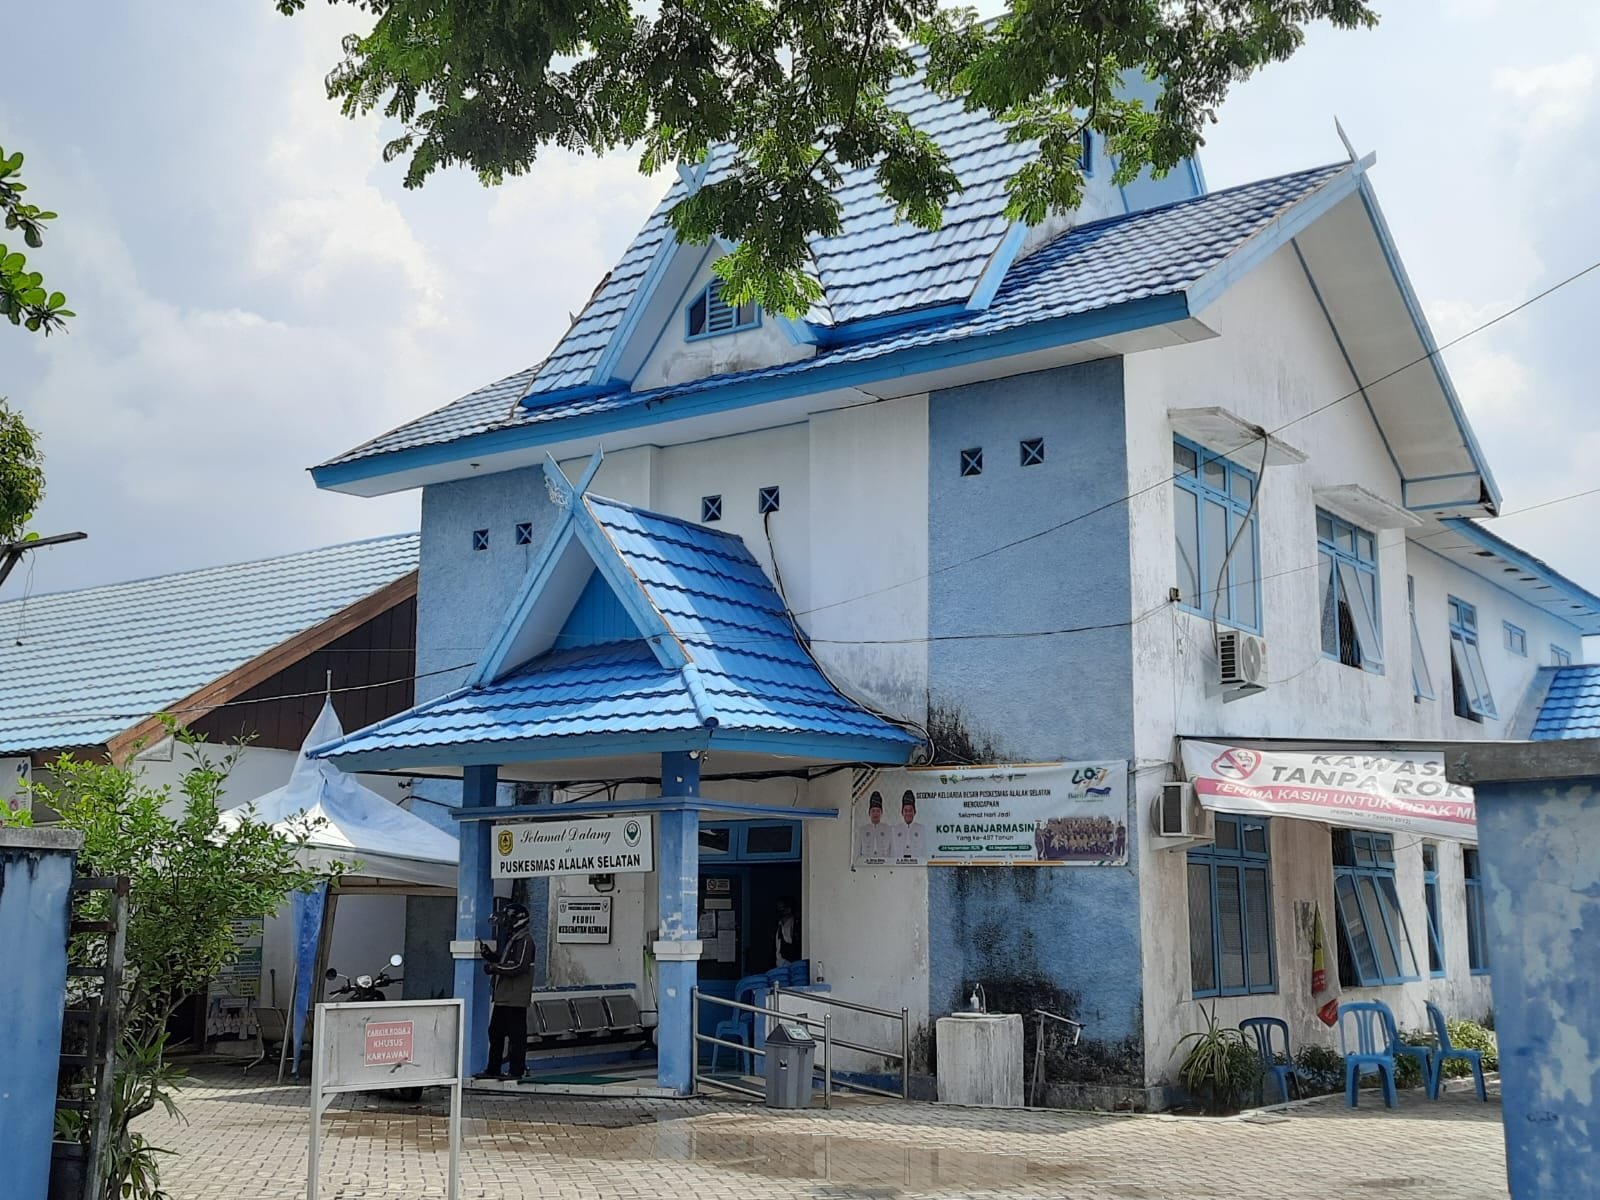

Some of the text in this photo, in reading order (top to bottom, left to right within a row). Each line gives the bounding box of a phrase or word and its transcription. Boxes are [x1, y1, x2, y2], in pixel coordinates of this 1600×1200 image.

[1311, 755, 1446, 777] KAWAS
[1272, 766, 1466, 798] TANPA ROK
[1215, 782, 1273, 800] TERIMA
[1277, 789, 1328, 802] KASIH
[1333, 793, 1392, 810] UNTUK
[1395, 800, 1452, 817] TIDAK
[997, 810, 1011, 818] Jadi
[936, 823, 1035, 833] KOTA BANJARMASIN
[520, 826, 611, 845] Selamat Datang
[956, 834, 971, 842] Yang
[500, 853, 641, 874] PUSKESMAS ALALAK SELATAN
[572, 915, 596, 924] PEDULI
[373, 1038, 404, 1048] KHUSUS
[367, 1050, 409, 1061] KARYAWAN
